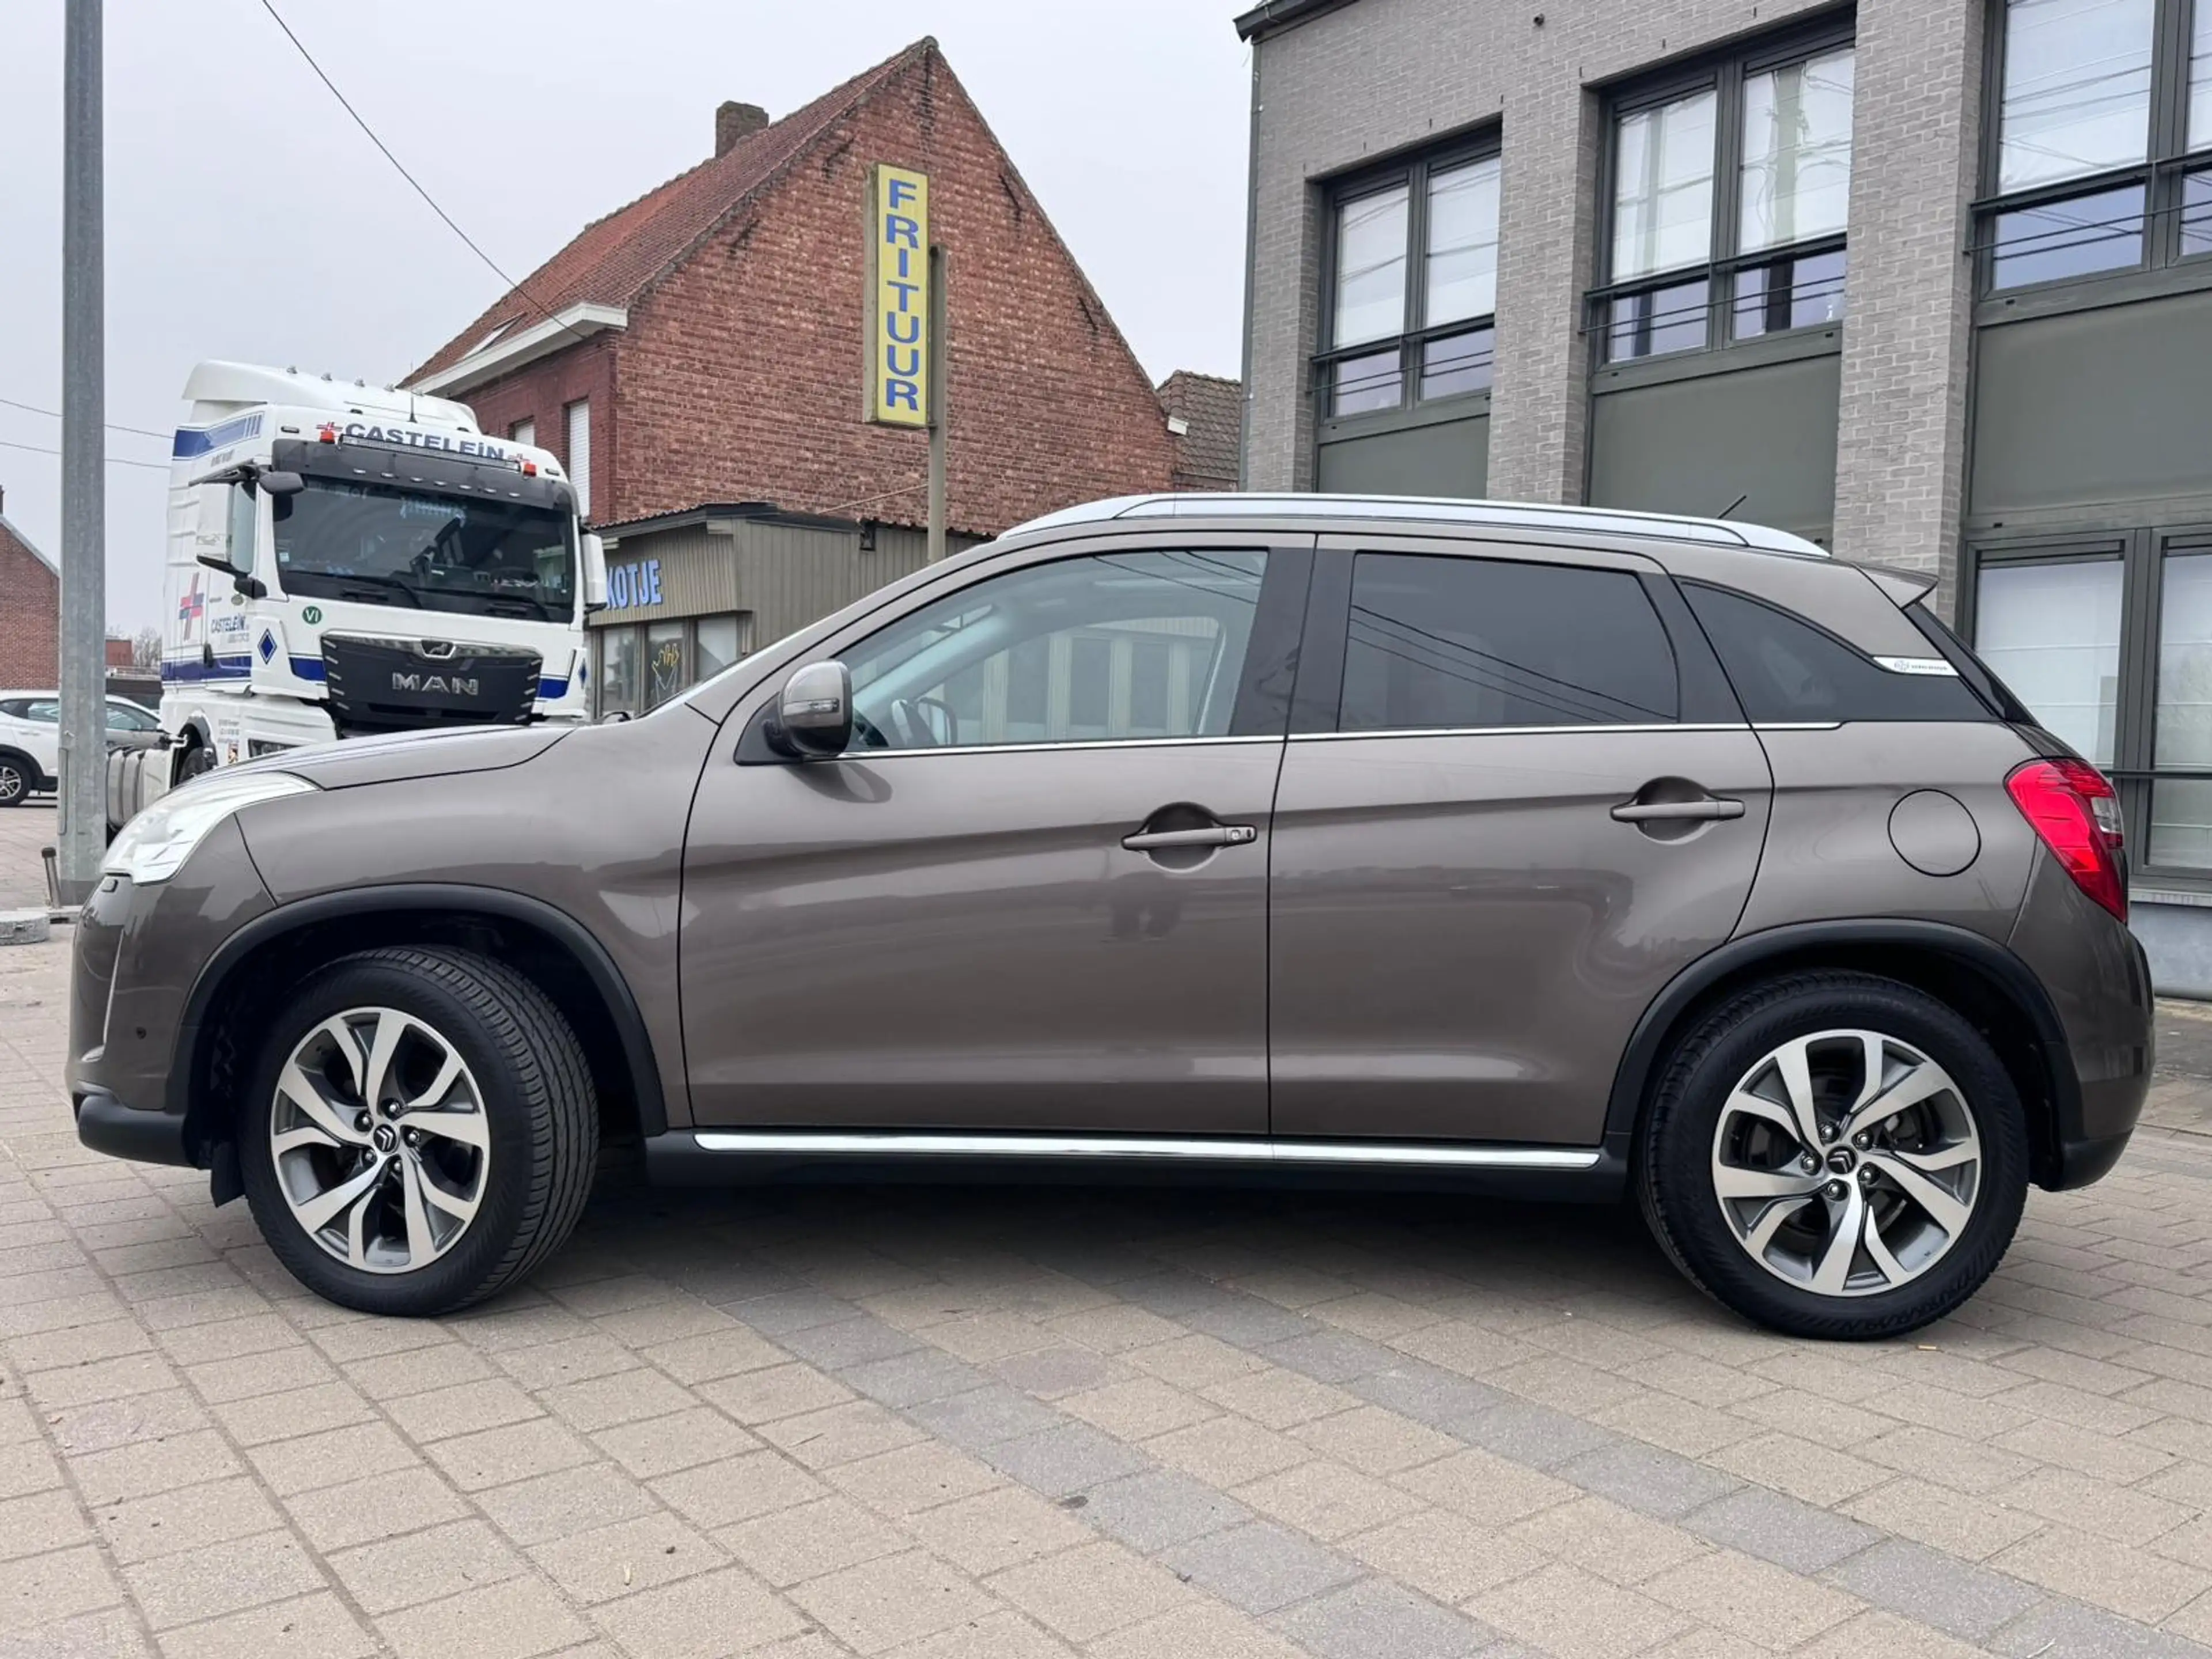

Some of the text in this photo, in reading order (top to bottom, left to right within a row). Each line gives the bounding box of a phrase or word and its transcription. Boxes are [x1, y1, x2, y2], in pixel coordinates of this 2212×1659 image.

[886, 178, 920, 412] FRITUUR
[605, 559, 663, 609] KOTJE
[392, 672, 479, 696] MAN
